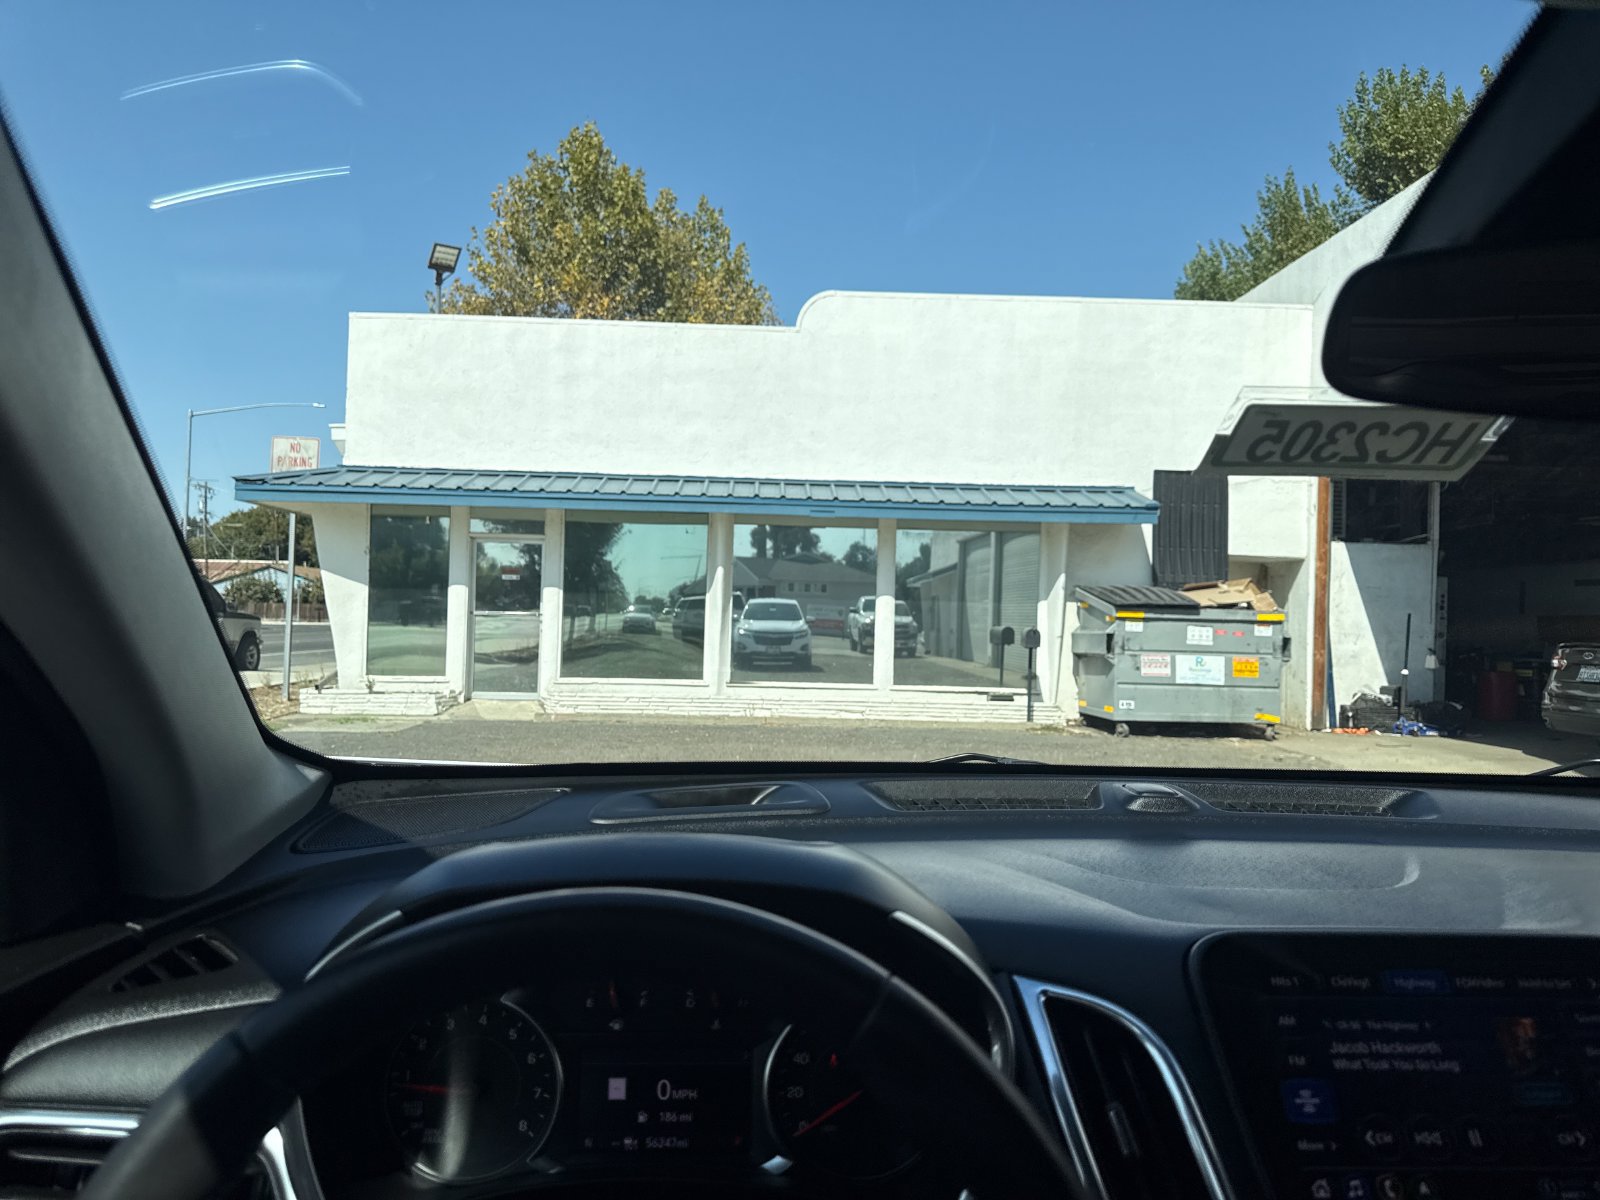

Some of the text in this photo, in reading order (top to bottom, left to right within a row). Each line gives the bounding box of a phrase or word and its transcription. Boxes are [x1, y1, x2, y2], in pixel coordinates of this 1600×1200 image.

[290, 442, 301, 454] NO
[277, 456, 313, 469] PARKING
[509, 1028, 518, 1041] 5
[527, 1052, 536, 1065] 6
[793, 1052, 810, 1065] 40
[534, 1087, 542, 1100] 7
[656, 1078, 699, 1101] 0 MPH
[786, 1086, 804, 1099] 20
[518, 1119, 528, 1132] 8
